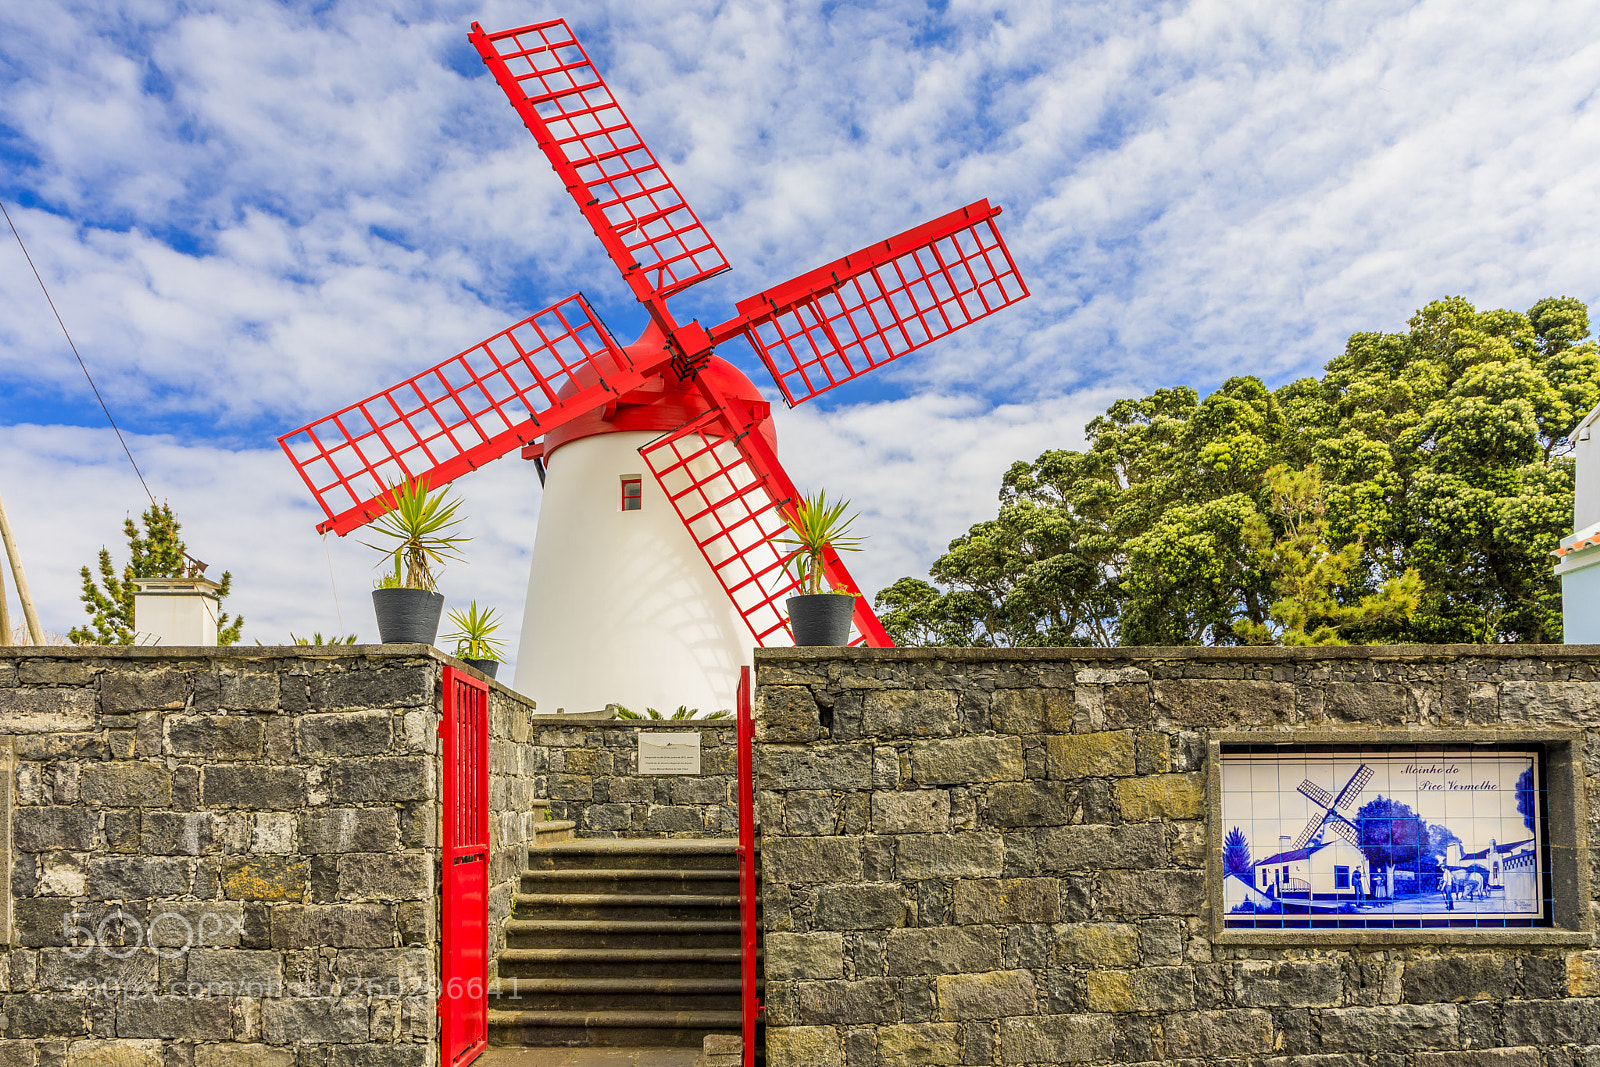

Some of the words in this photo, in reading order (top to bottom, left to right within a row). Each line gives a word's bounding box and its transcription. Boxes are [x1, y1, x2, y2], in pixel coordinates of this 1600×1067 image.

[1400, 764, 1443, 774] Moinho
[1445, 764, 1460, 774] do
[1418, 780, 1444, 791] Pico
[1448, 780, 1499, 791] Vermelho
